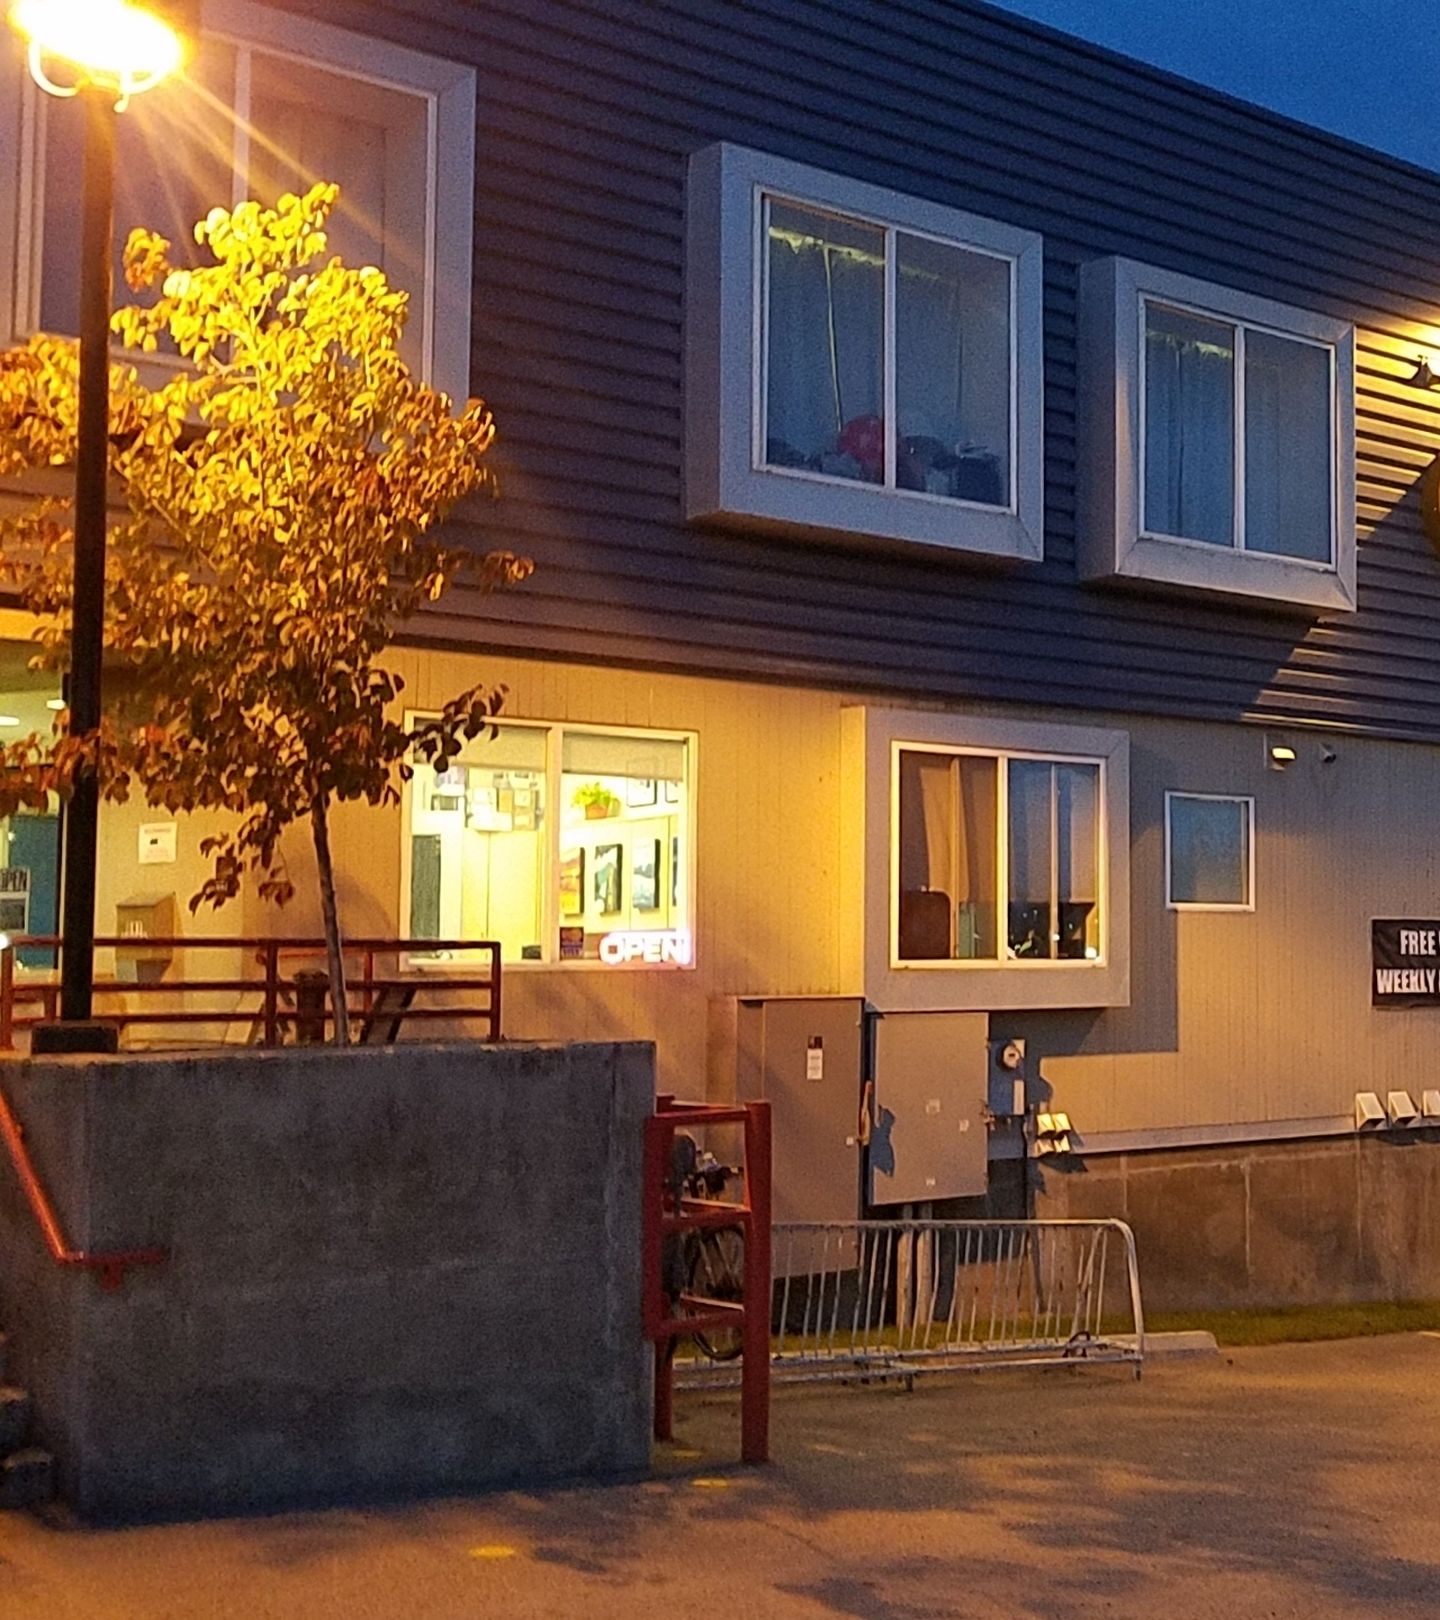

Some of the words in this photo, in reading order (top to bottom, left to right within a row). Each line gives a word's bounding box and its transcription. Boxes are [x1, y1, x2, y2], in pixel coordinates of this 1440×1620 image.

[599, 931, 691, 965] OPEN
[1400, 929, 1436, 955] FREE
[1376, 969, 1436, 994] WEEKLY
